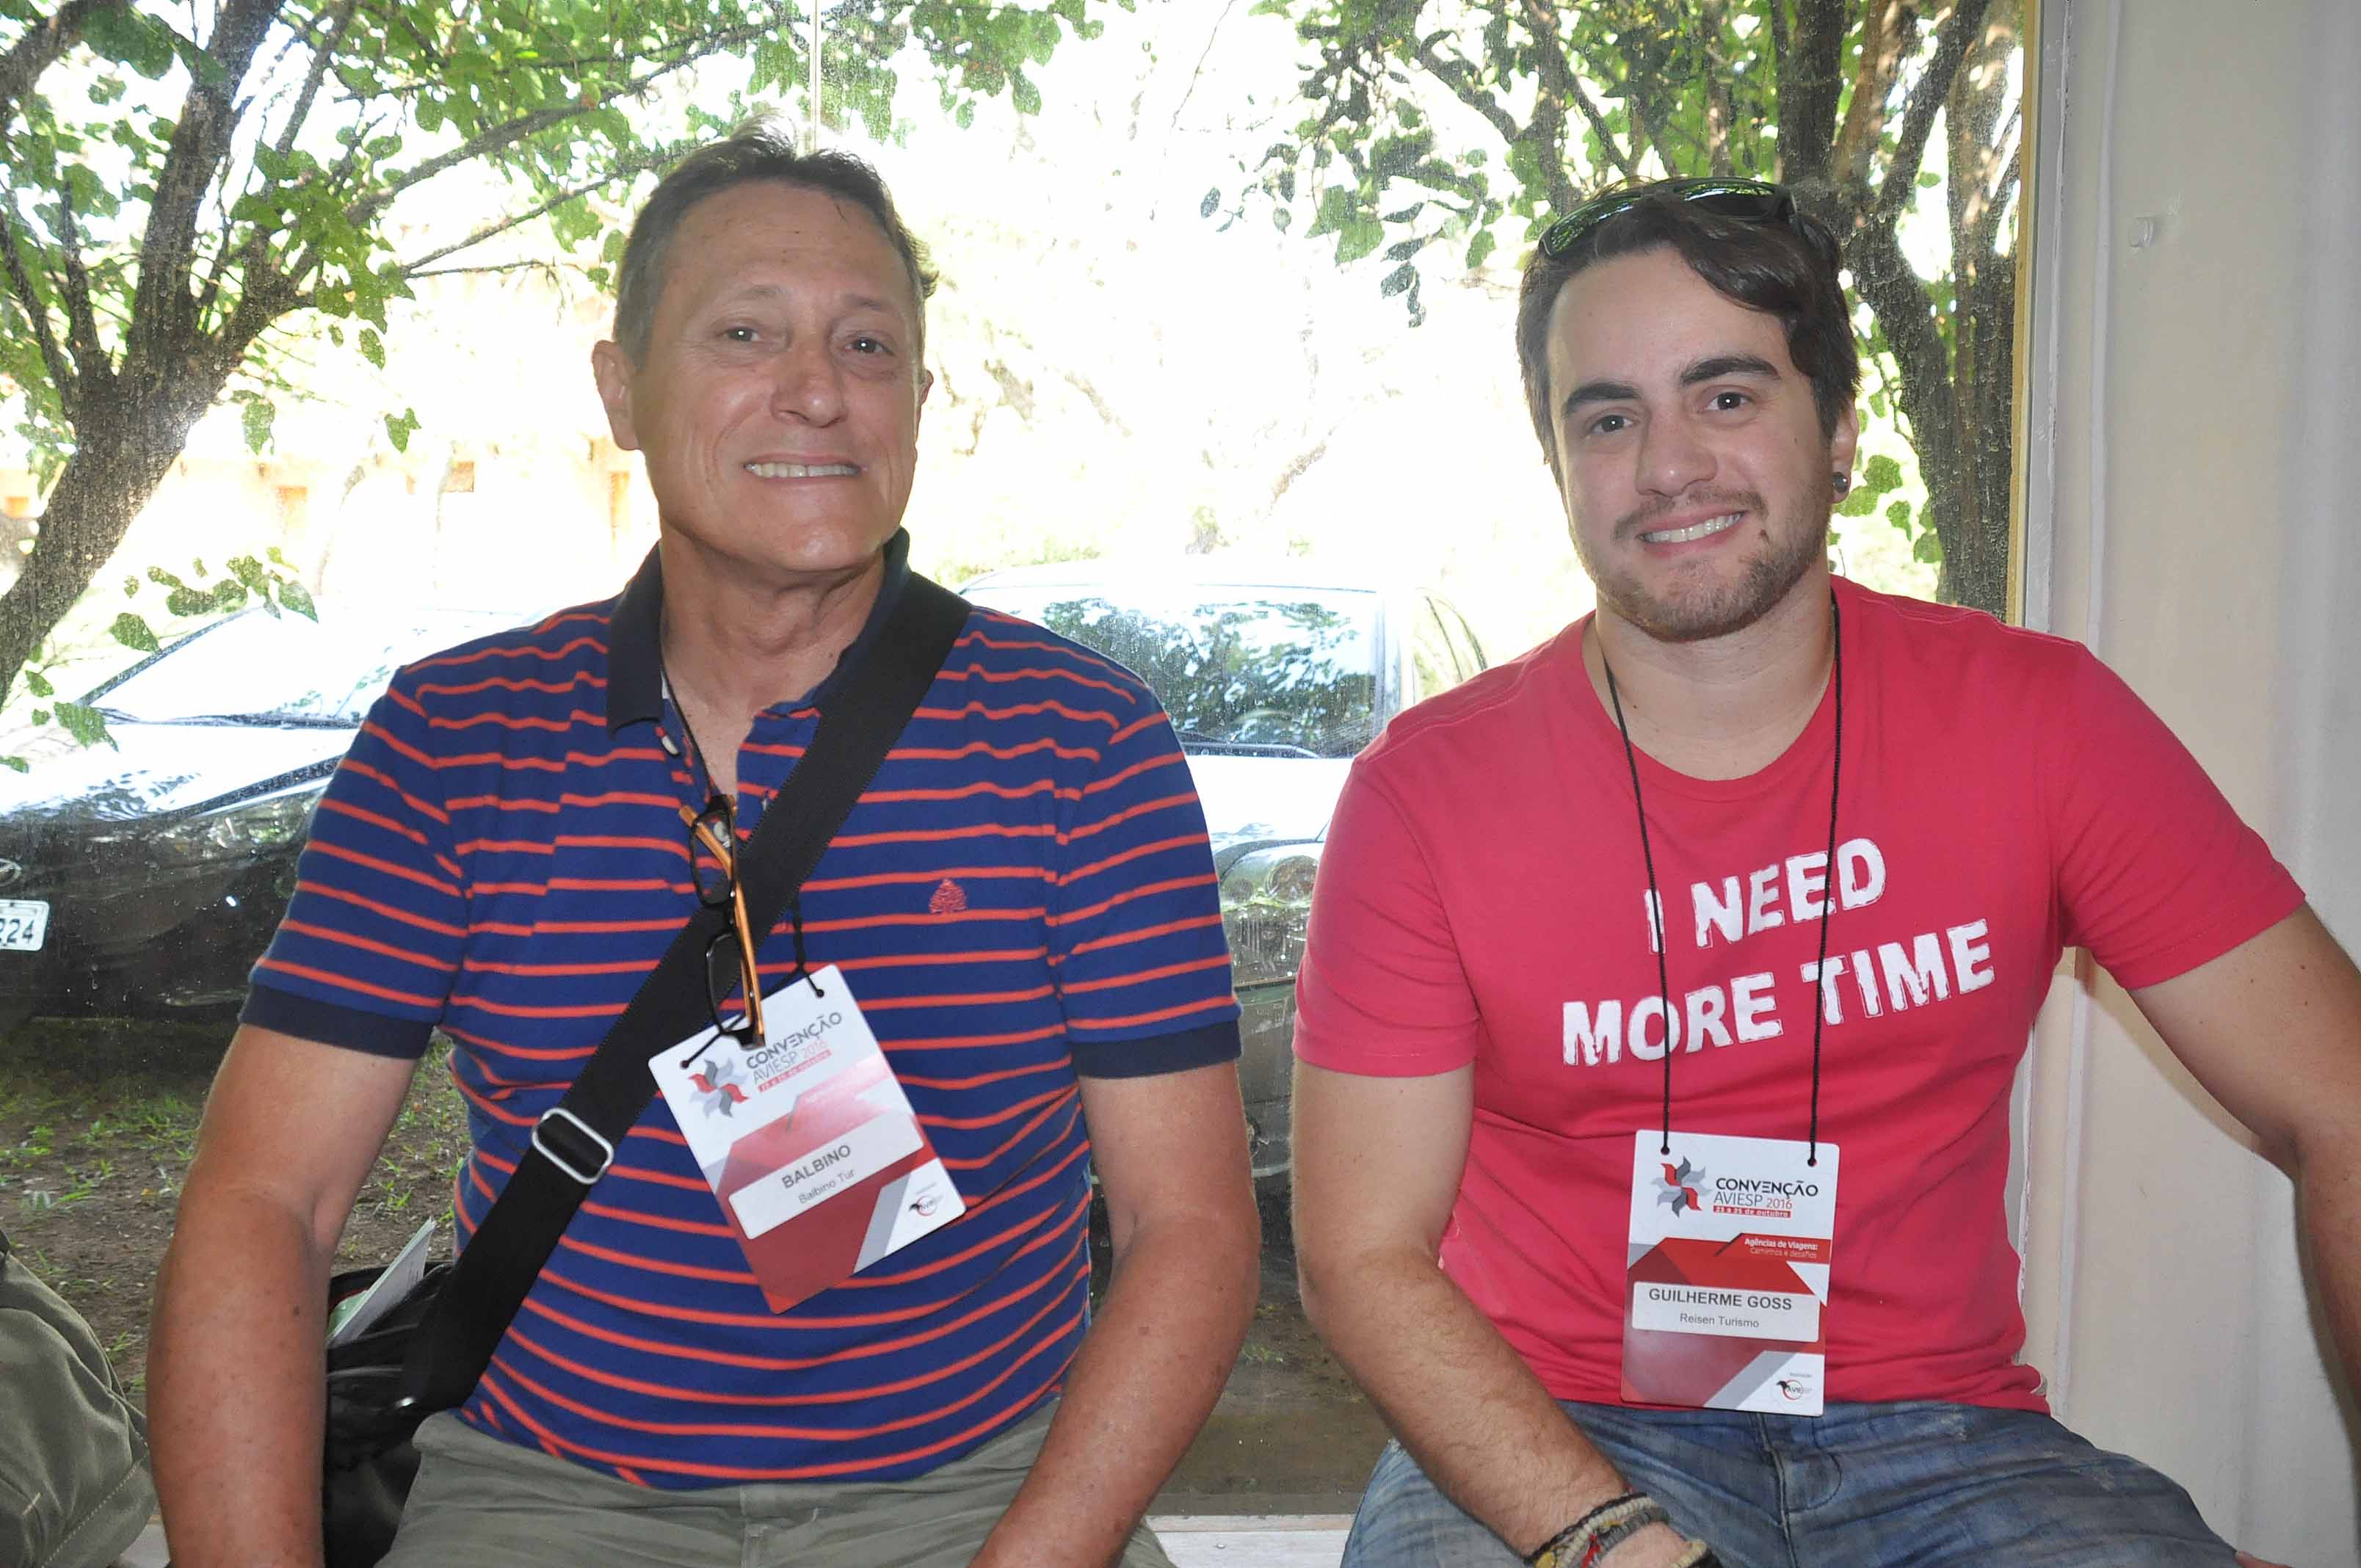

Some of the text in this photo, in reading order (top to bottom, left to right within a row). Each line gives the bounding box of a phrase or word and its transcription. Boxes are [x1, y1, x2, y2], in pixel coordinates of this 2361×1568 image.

[1644, 838, 1887, 954] I NEED
[1562, 918, 1995, 1067] MORE TIME
[746, 1012, 842, 1069] CONVENÇÃO
[753, 1051, 797, 1084] AVIESP
[781, 1145, 851, 1188] BALBINO
[798, 1169, 855, 1204] Balbino Tur
[1716, 1177, 1818, 1199] CONVENÇÃO
[1713, 1191, 1793, 1210] AVIESP 2016
[1744, 1208, 1755, 1216] de
[1756, 1209, 1788, 1217] outubro
[1744, 1238, 1777, 1247] Agências
[1777, 1240, 1787, 1249] de
[1649, 1288, 1792, 1310] GUILHERME GOSS
[1680, 1313, 1760, 1328] Reisen Turismo
